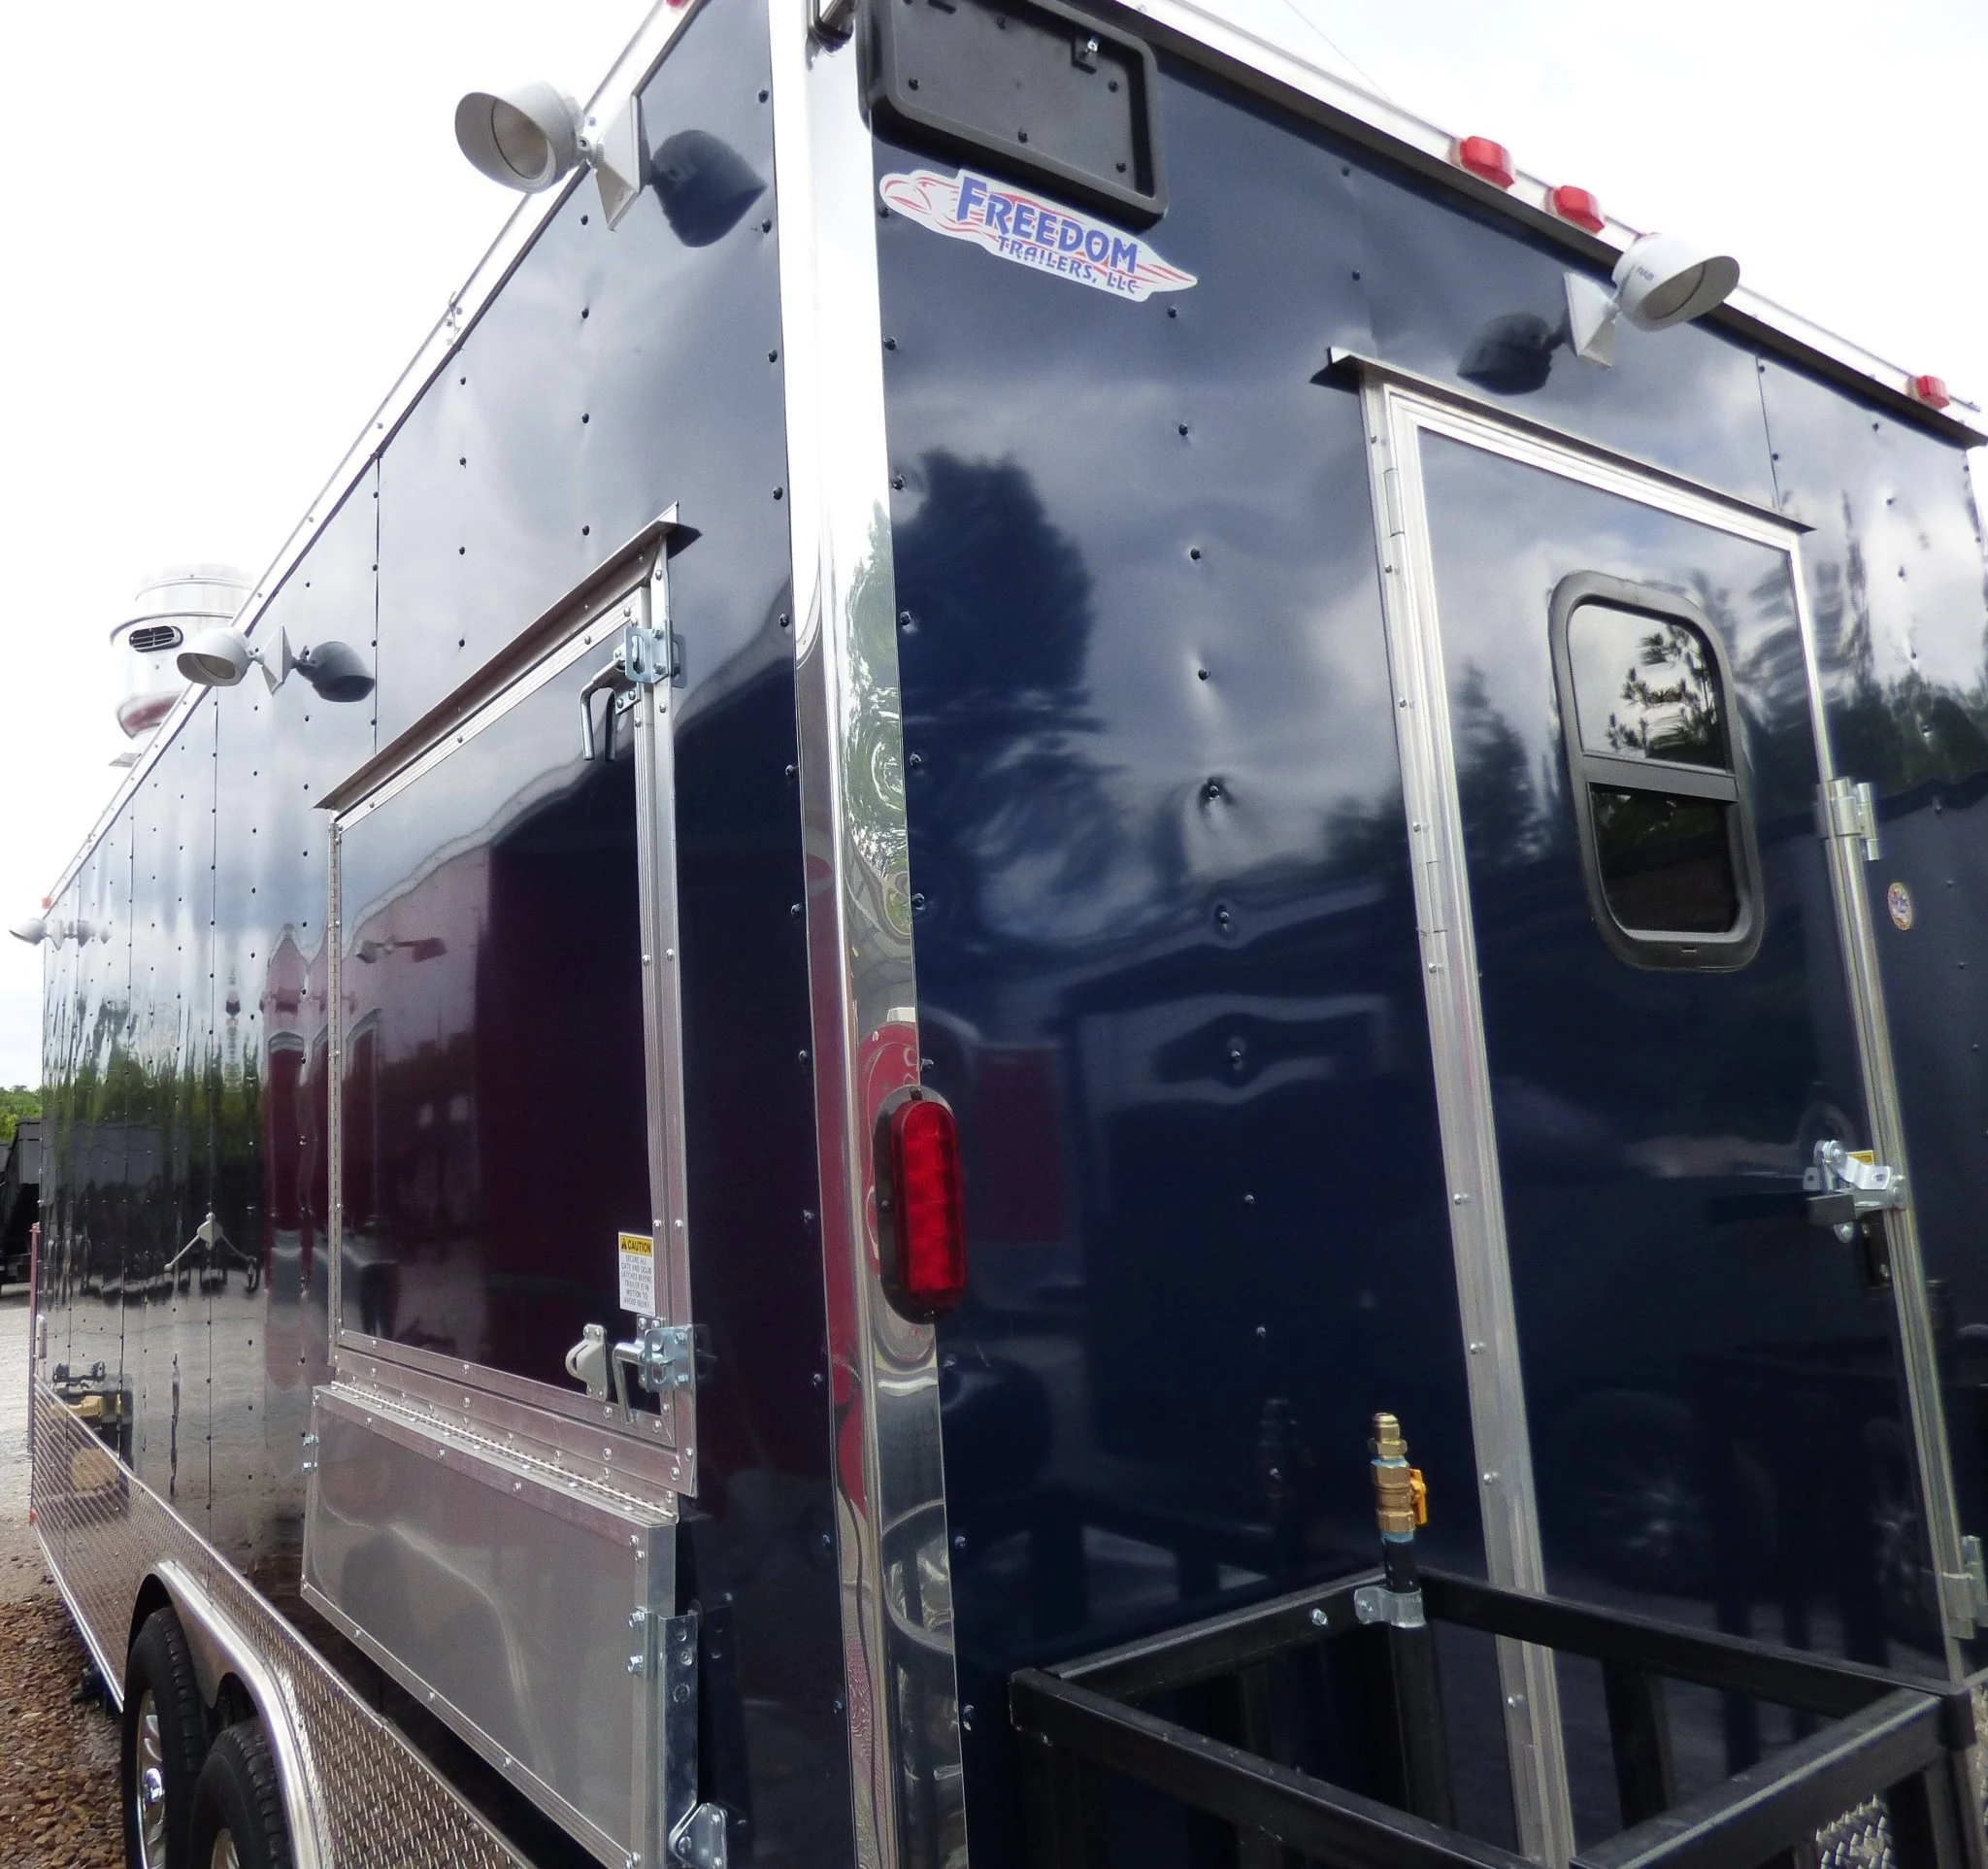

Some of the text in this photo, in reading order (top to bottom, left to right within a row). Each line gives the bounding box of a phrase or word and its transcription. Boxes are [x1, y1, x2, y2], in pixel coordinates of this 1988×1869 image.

[956, 176, 1138, 275] FREEDOM
[998, 235, 1139, 294] TRAILERS, LLC
[627, 1240, 651, 1253] CAUTION
